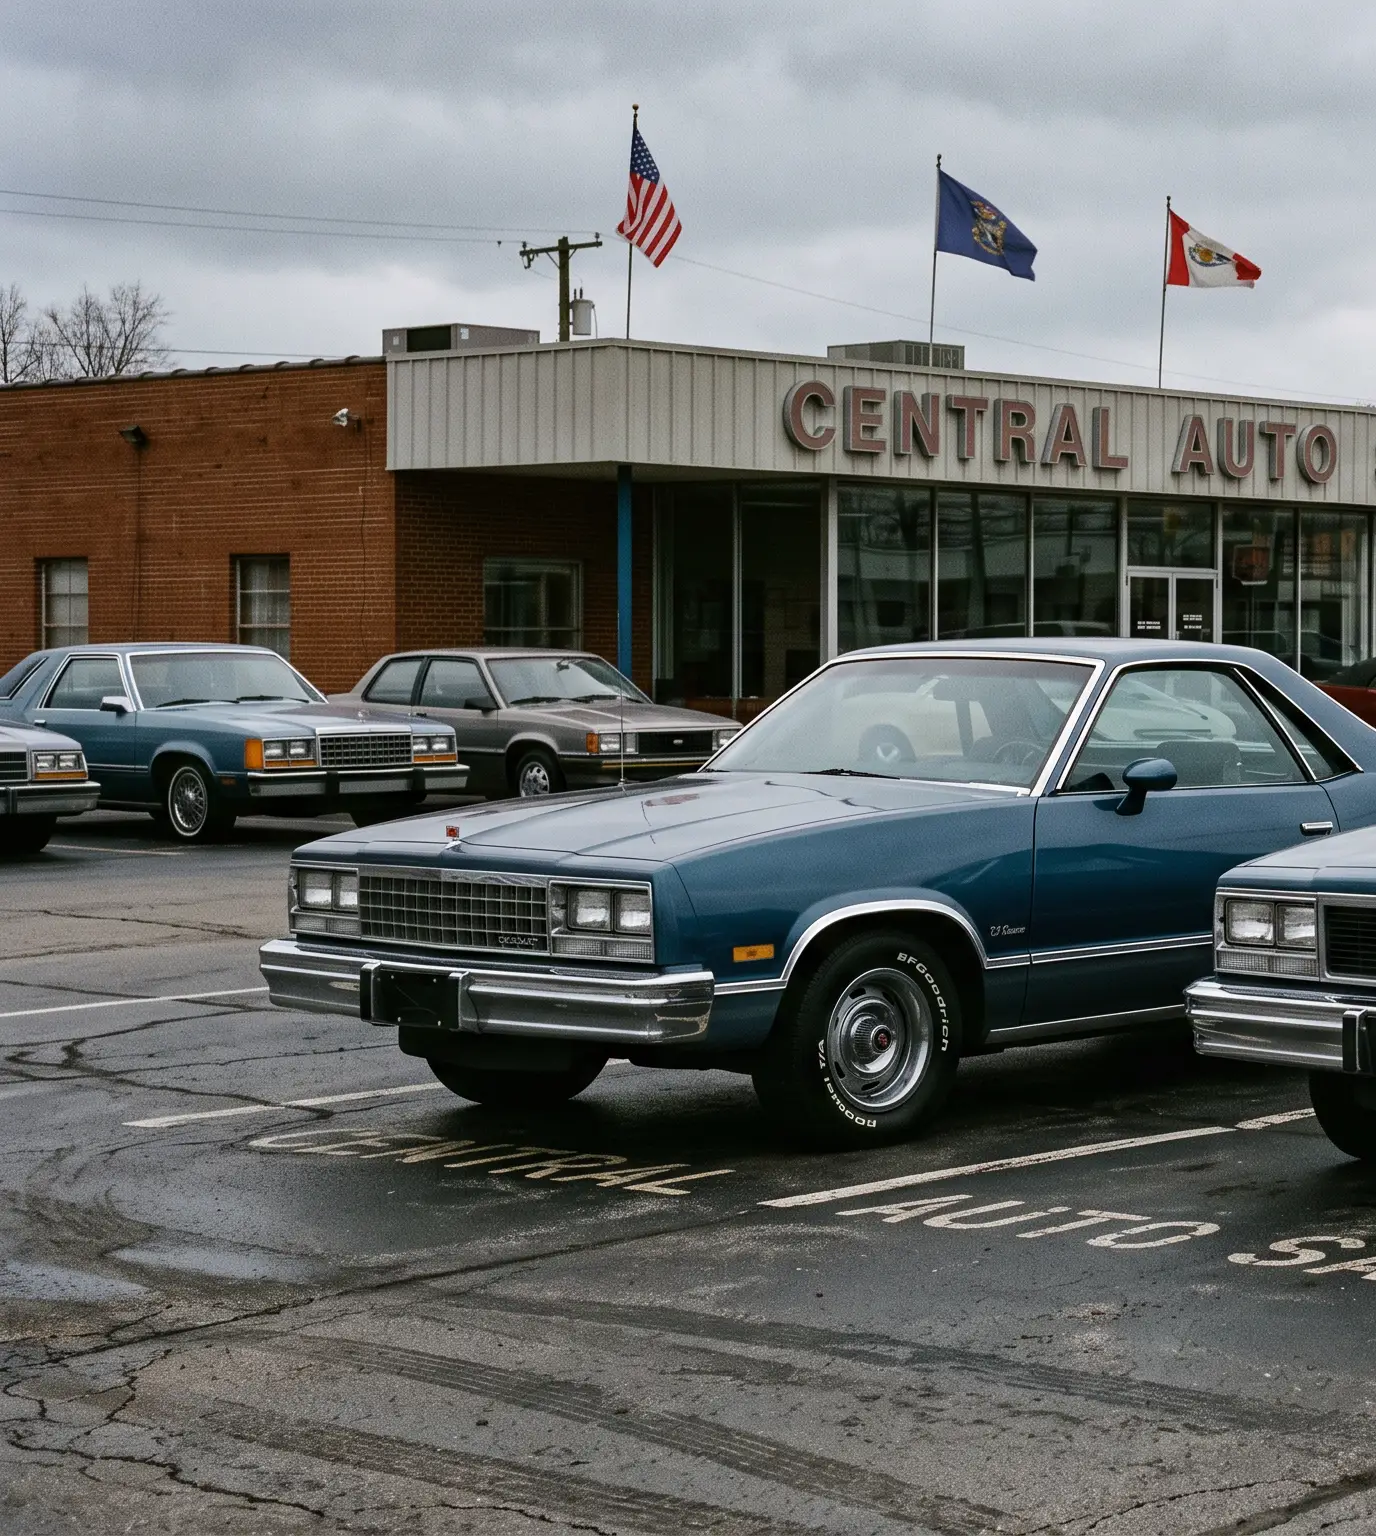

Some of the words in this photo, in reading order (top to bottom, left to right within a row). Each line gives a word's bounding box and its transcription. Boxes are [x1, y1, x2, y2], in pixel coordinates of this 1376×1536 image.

[784, 380, 1129, 469] CENTRAL
[1172, 415, 1337, 484] AUTO
[254, 1131, 735, 1196] CENTRAL
[838, 1195, 1220, 1249] AUTO
